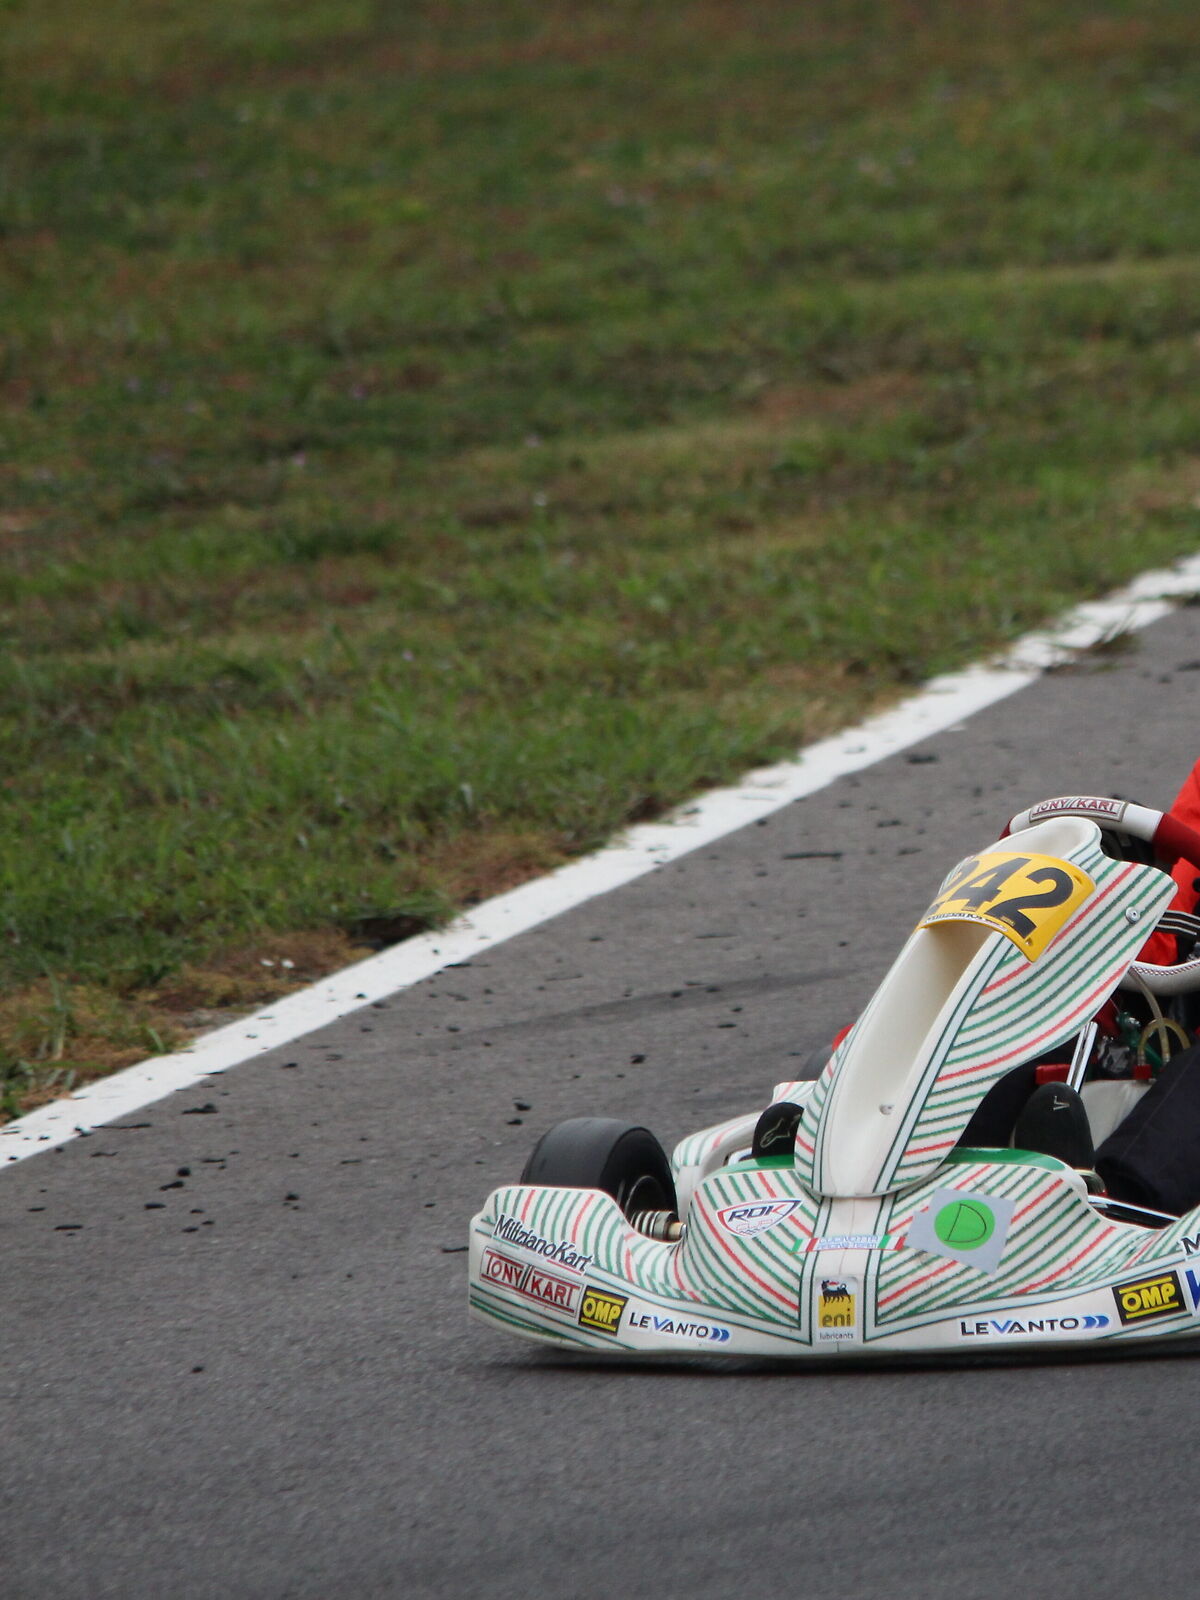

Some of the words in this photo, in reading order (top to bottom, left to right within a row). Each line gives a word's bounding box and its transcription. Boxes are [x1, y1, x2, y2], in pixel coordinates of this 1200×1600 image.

[1076, 797, 1117, 812] KART
[924, 857, 1074, 940] 242
[727, 1203, 788, 1222] ROK
[944, 1203, 987, 1243] D
[494, 1213, 593, 1272] MilizianoKart
[484, 1249, 525, 1287] TONY
[530, 1270, 581, 1307] KART
[582, 1297, 621, 1324] OMP
[1121, 1283, 1177, 1313] OMP
[628, 1312, 709, 1339] LEVANTO
[822, 1308, 851, 1328] eni
[960, 1317, 1080, 1337] LEVANTO
